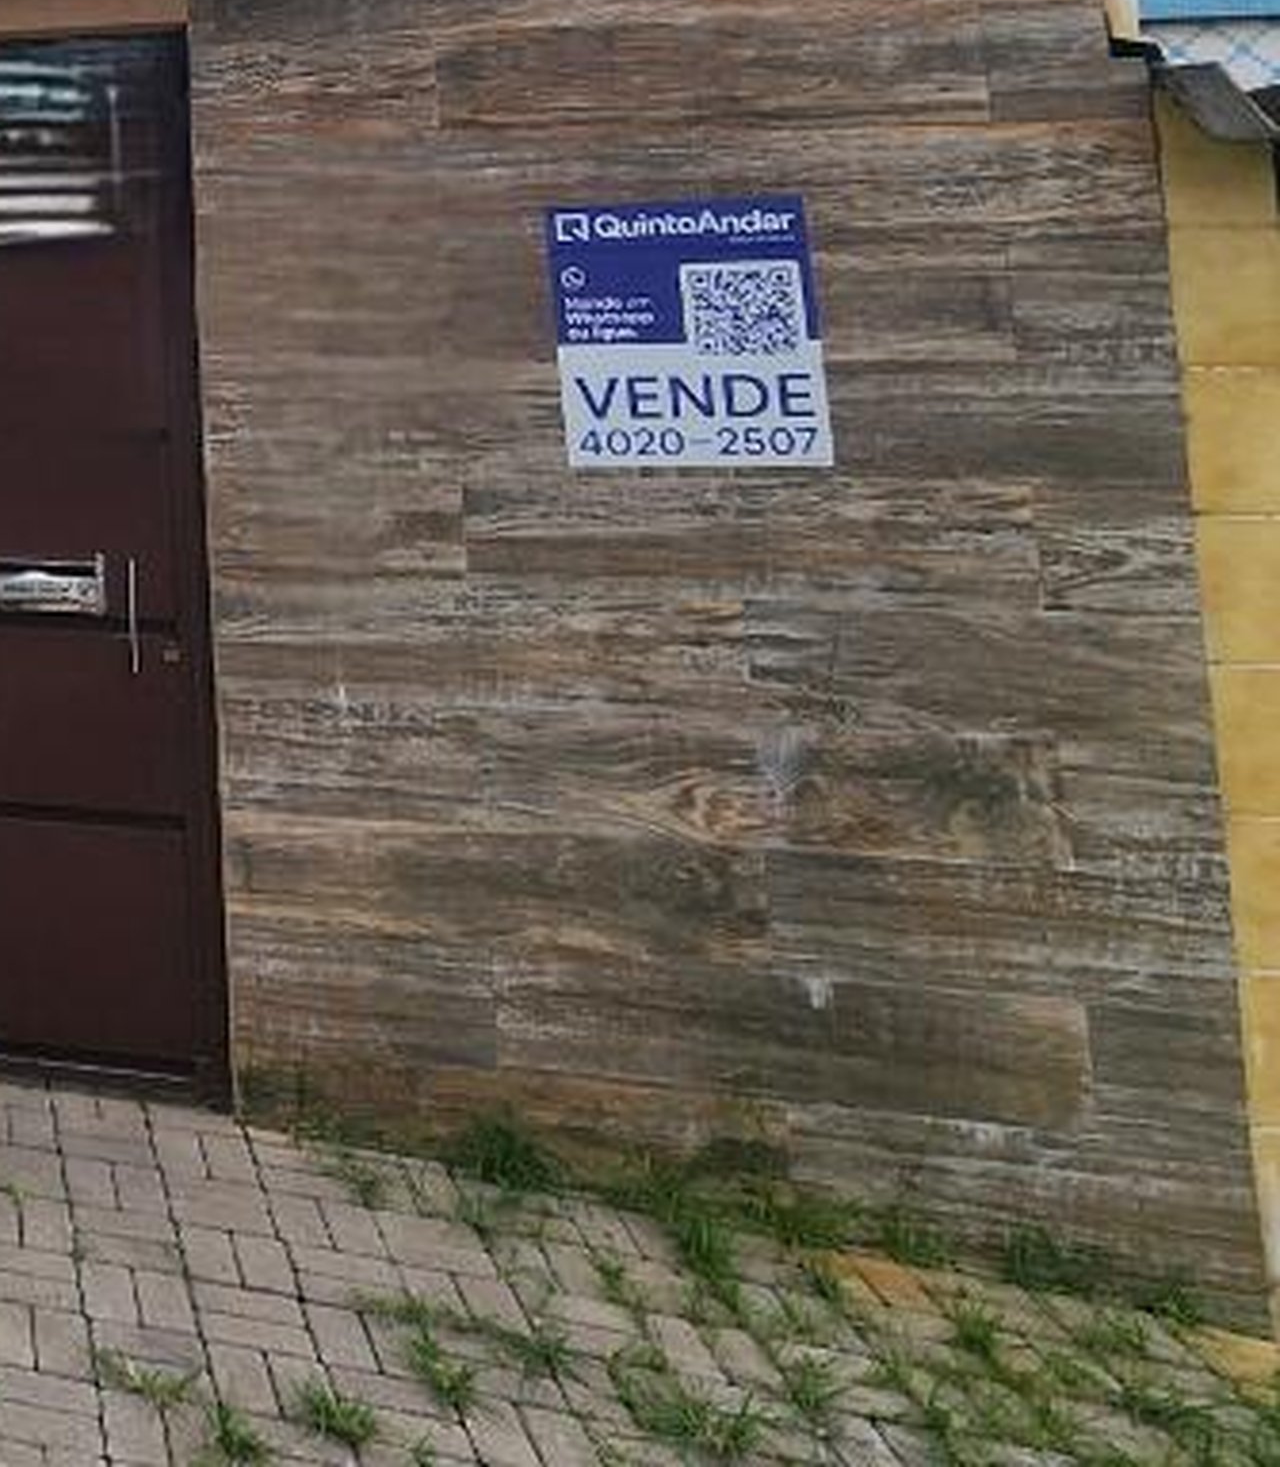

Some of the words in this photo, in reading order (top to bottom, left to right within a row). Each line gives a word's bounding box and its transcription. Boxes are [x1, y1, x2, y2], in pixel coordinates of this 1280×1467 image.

[594, 209, 795, 238] QuintoAndar
[574, 373, 816, 420] VENDE
[580, 427, 818, 457] 4020-2507
